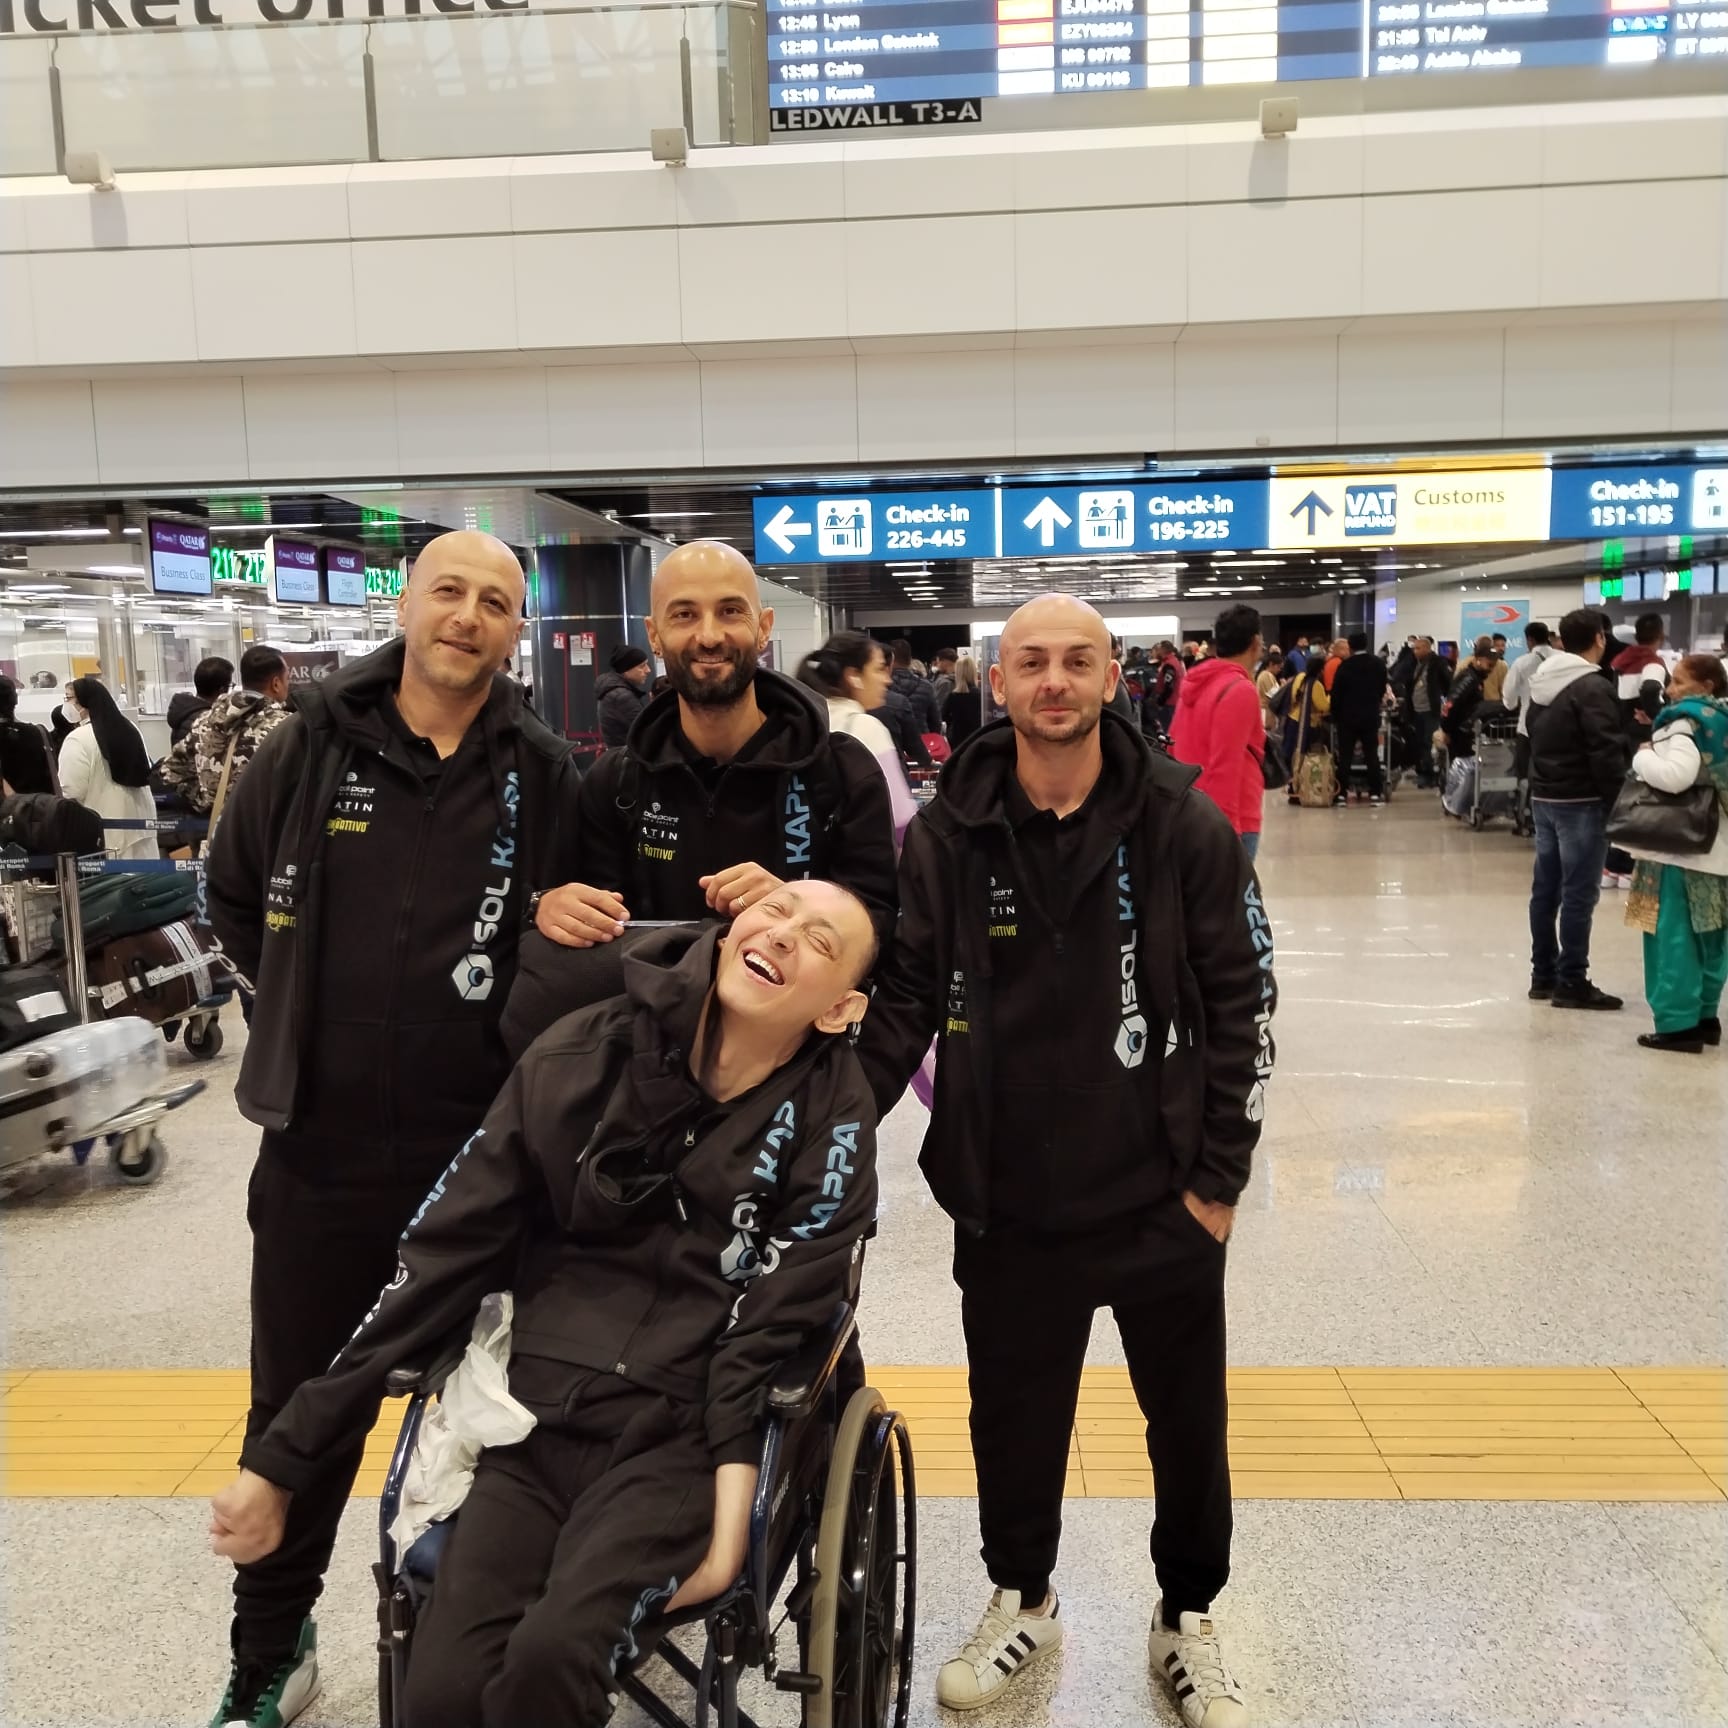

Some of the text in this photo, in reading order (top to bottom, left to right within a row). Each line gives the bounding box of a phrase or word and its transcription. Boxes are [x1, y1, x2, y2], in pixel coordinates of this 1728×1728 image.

[823, 13, 861, 31] Lyon
[823, 36, 880, 51] London
[824, 61, 864, 77] Cairo
[825, 84, 876, 100] Kuwait
[771, 101, 979, 129] LEDWALL T3-A
[1414, 489, 1505, 505] Customs
[1590, 478, 1679, 501] Check-in
[886, 503, 970, 524] Check-in
[1148, 494, 1234, 516] Check-in
[1345, 491, 1397, 516] VAT
[1344, 514, 1396, 528] REFUND
[1591, 504, 1674, 526] 151-195
[887, 528, 966, 549] 226-445
[1149, 519, 1230, 541] 196-225
[161, 566, 206, 581] Business Class
[211, 547, 235, 579] 211
[1120, 929, 1139, 1015] ISOL
